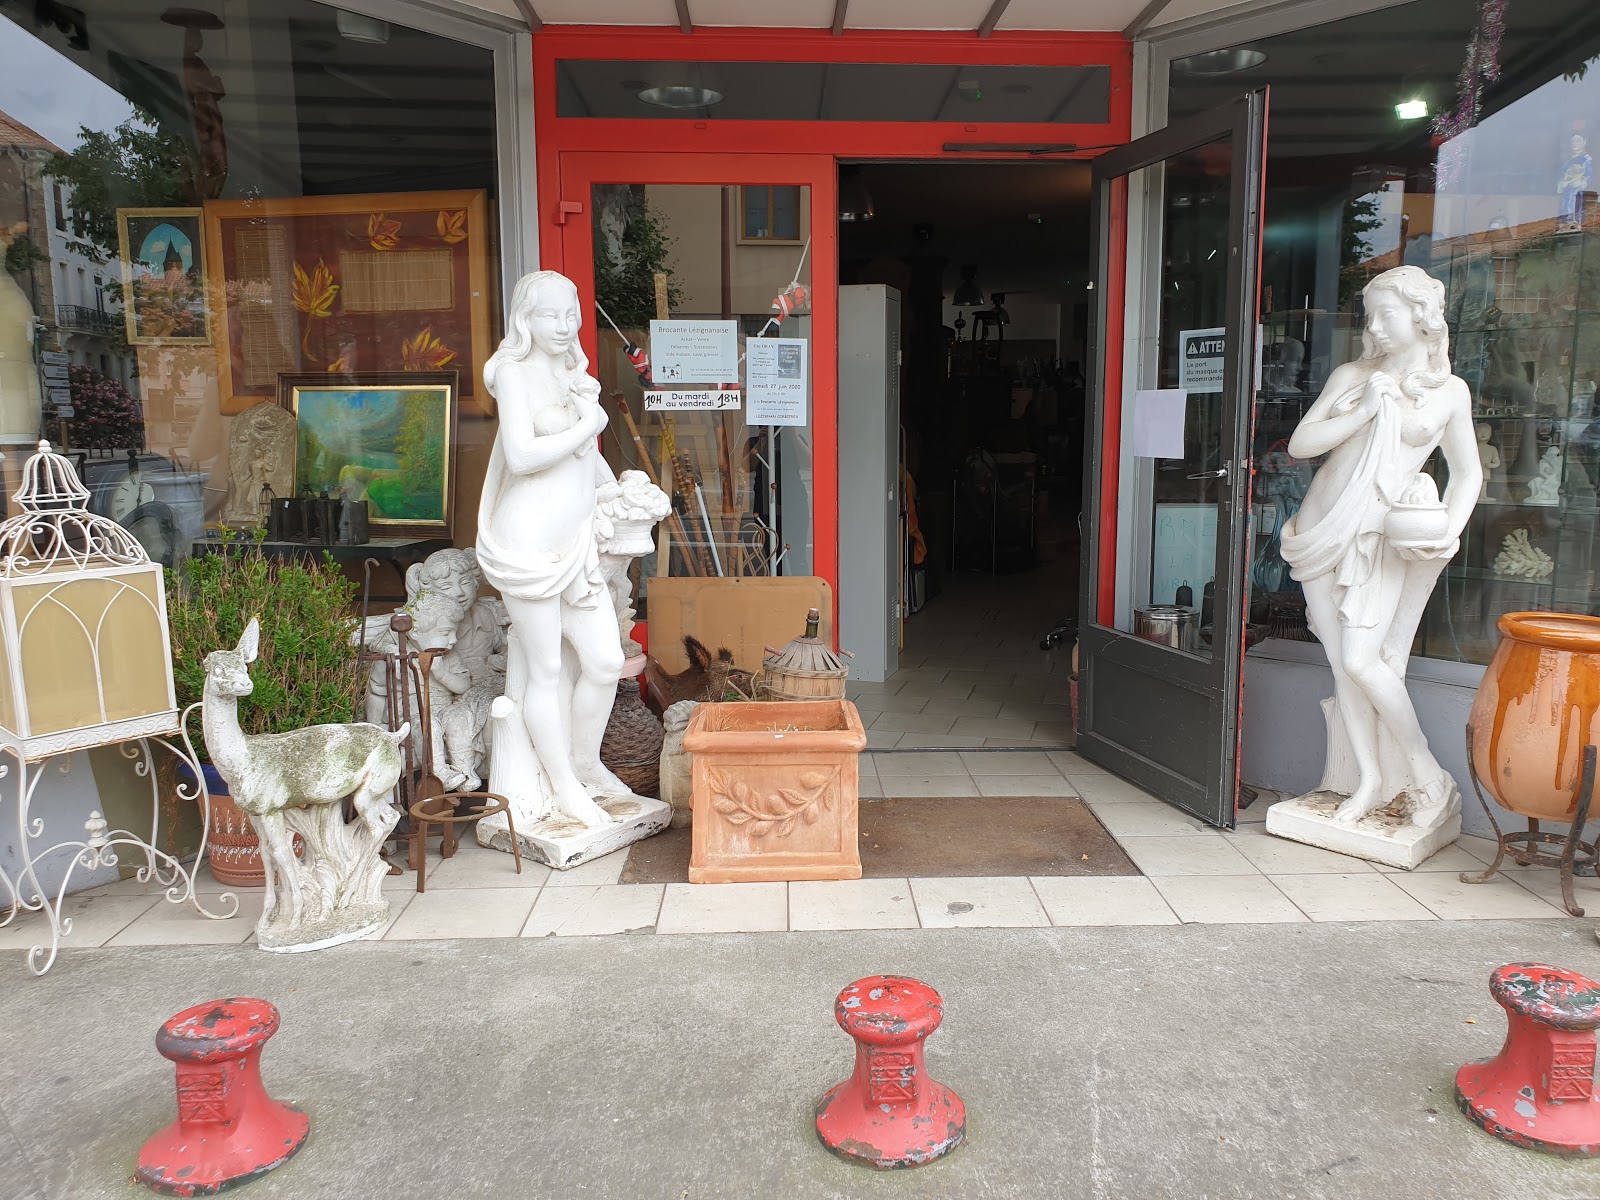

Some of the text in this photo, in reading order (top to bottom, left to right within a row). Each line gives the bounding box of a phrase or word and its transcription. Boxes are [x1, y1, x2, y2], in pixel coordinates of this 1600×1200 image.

[688, 326, 729, 334] Lézignanaise
[685, 392, 710, 400] mardi
[644, 394, 662, 410] 10H
[678, 400, 714, 408] vendredi
[717, 393, 739, 409] 18H
